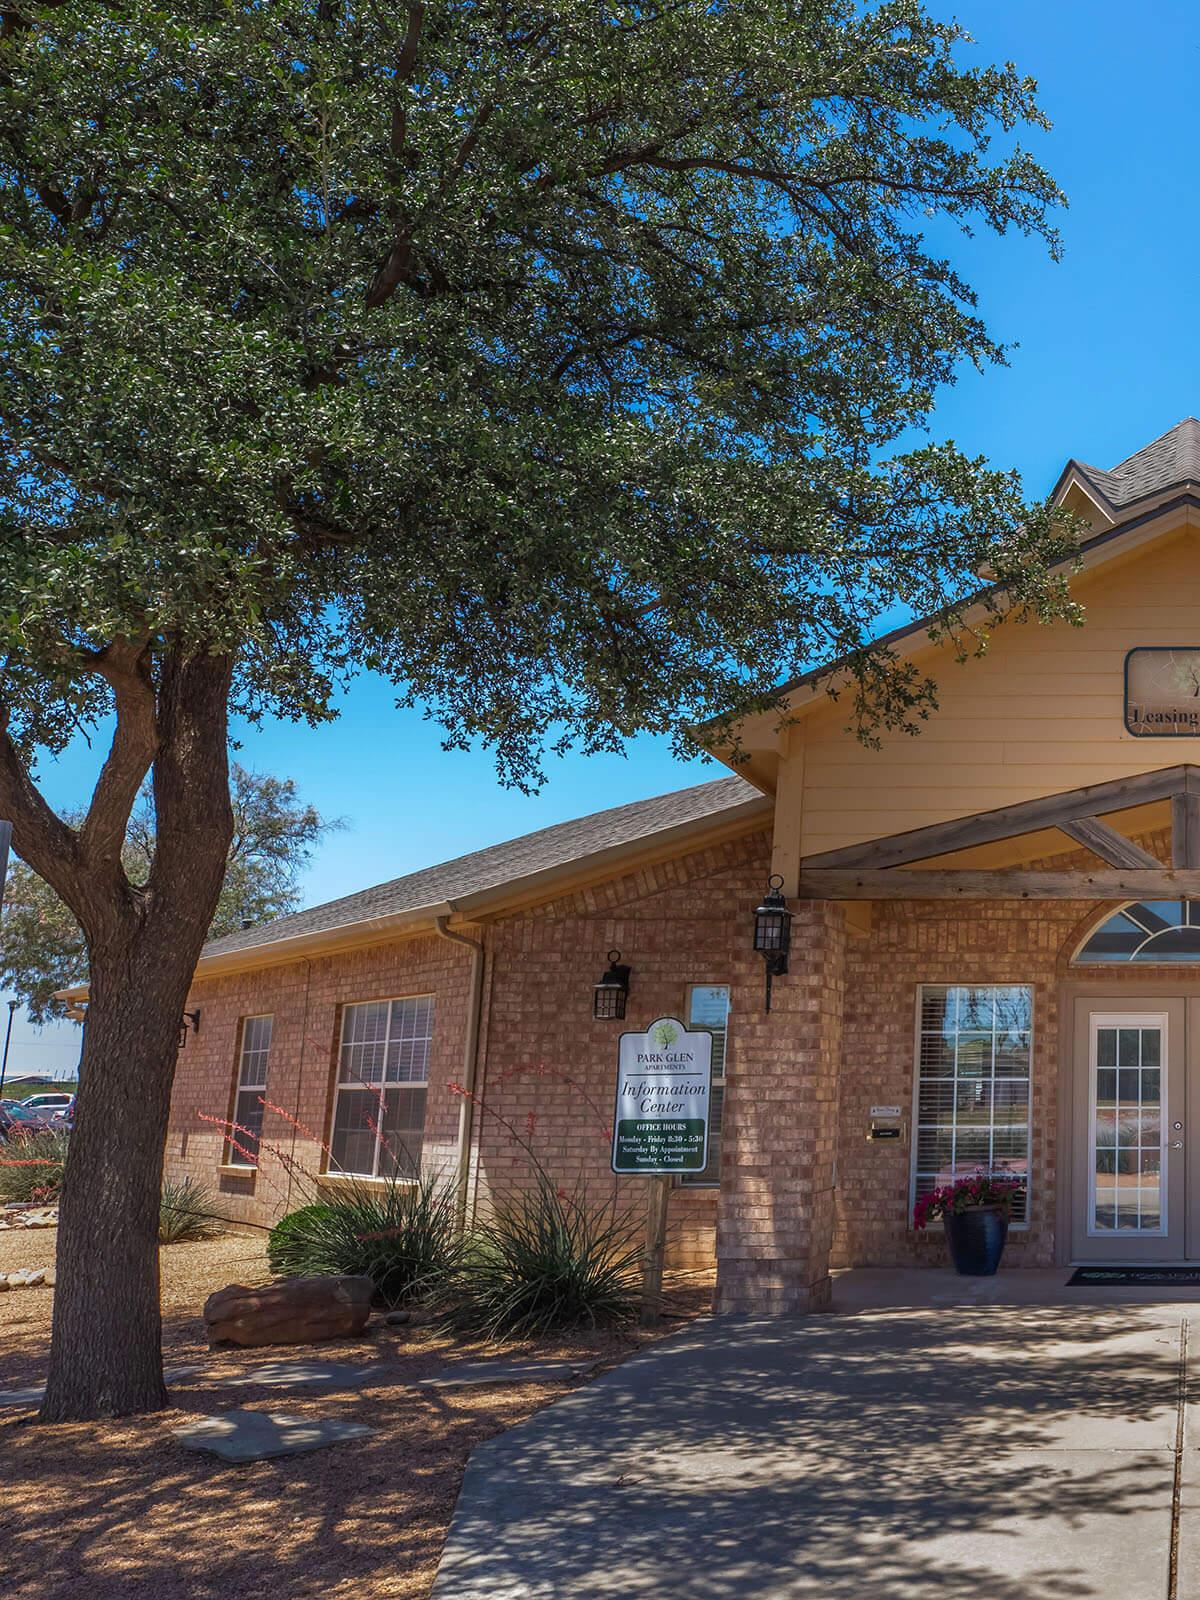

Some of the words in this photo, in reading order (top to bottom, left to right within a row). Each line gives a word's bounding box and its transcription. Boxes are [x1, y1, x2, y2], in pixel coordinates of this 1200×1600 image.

[1133, 709, 1199, 726] Leasing
[637, 1054, 663, 1063] PARK
[665, 1053, 694, 1062] GLEN
[622, 1080, 706, 1100] Information
[640, 1098, 685, 1113] Center
[636, 1123, 661, 1131] OFFICE
[662, 1122, 687, 1131] HOURS
[619, 1135, 642, 1144] Monday
[647, 1135, 666, 1144] Friday
[667, 1135, 683, 1143] 8:30
[688, 1135, 704, 1143] 5:30
[622, 1145, 648, 1154] Saturday
[650, 1145, 658, 1154] By
[660, 1145, 698, 1154] Appointment
[635, 1155, 658, 1164] Sunday
